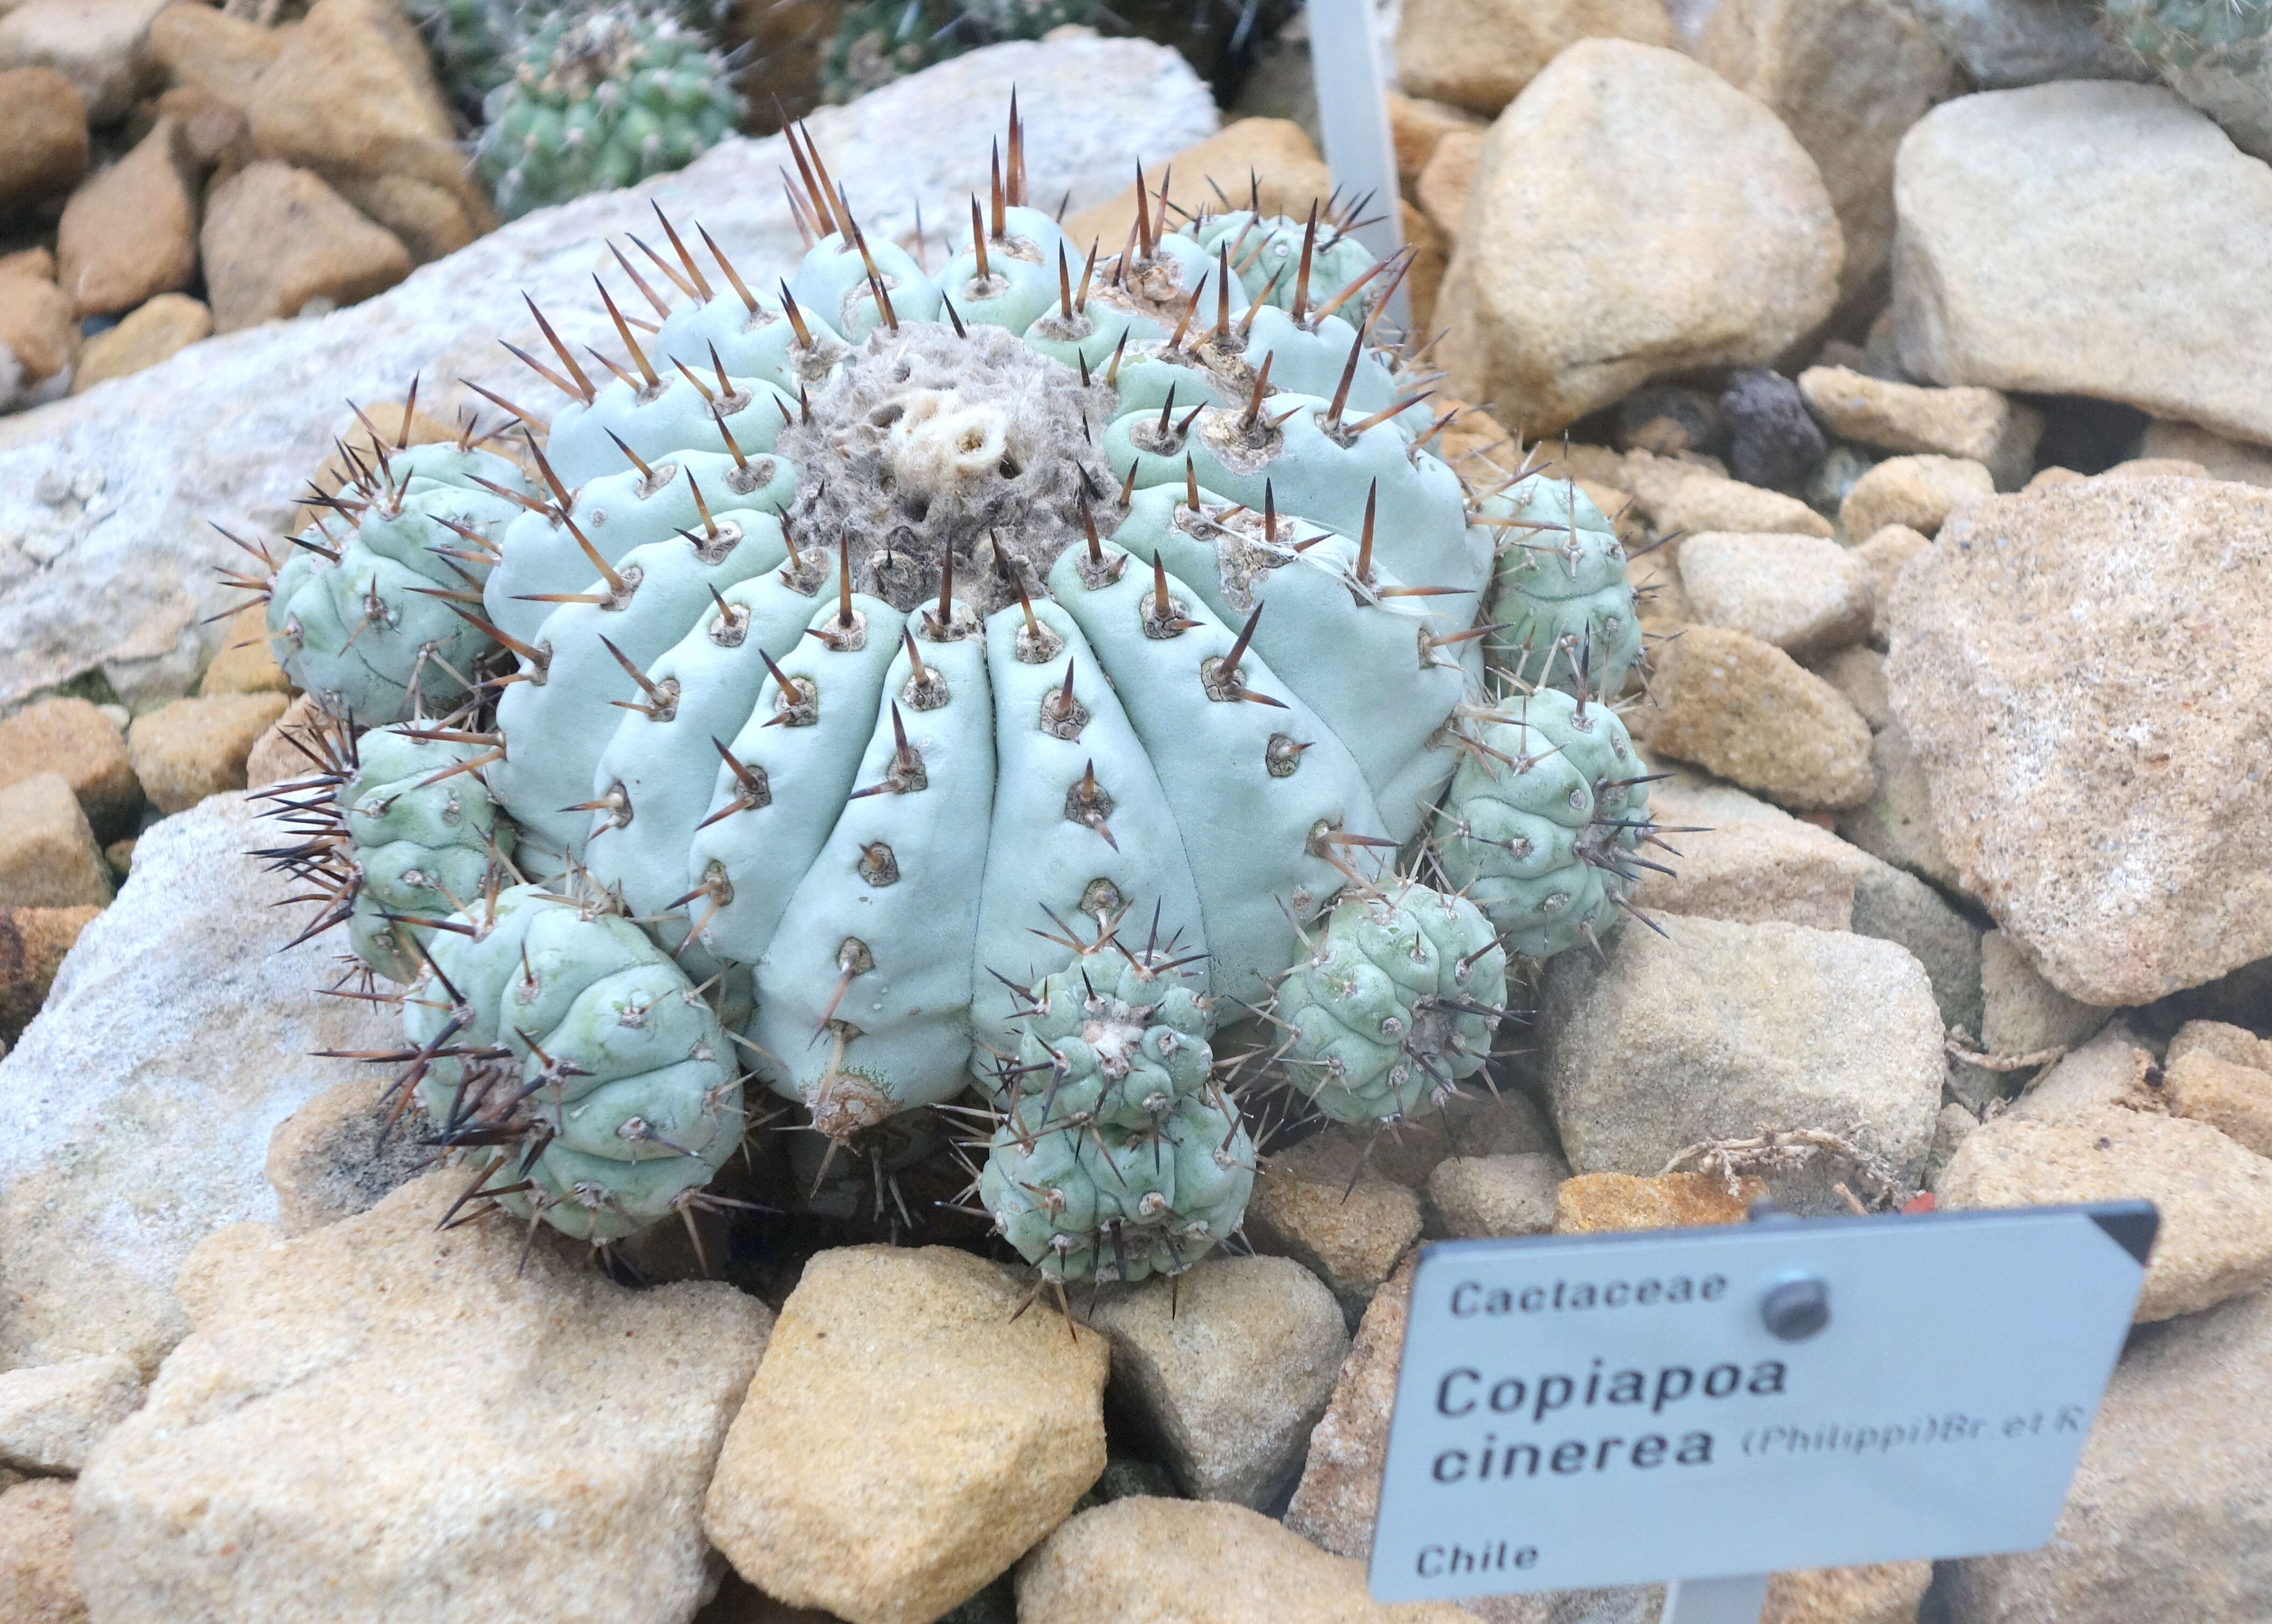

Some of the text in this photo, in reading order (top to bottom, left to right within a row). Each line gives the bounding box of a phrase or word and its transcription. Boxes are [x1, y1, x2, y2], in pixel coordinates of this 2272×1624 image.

[1450, 1274, 1726, 1317] Cactaceae
[1436, 1358, 1787, 1422] Copiapoa
[1431, 1432, 1713, 1484] cinerea
[1416, 1540, 1538, 1579] Chile
